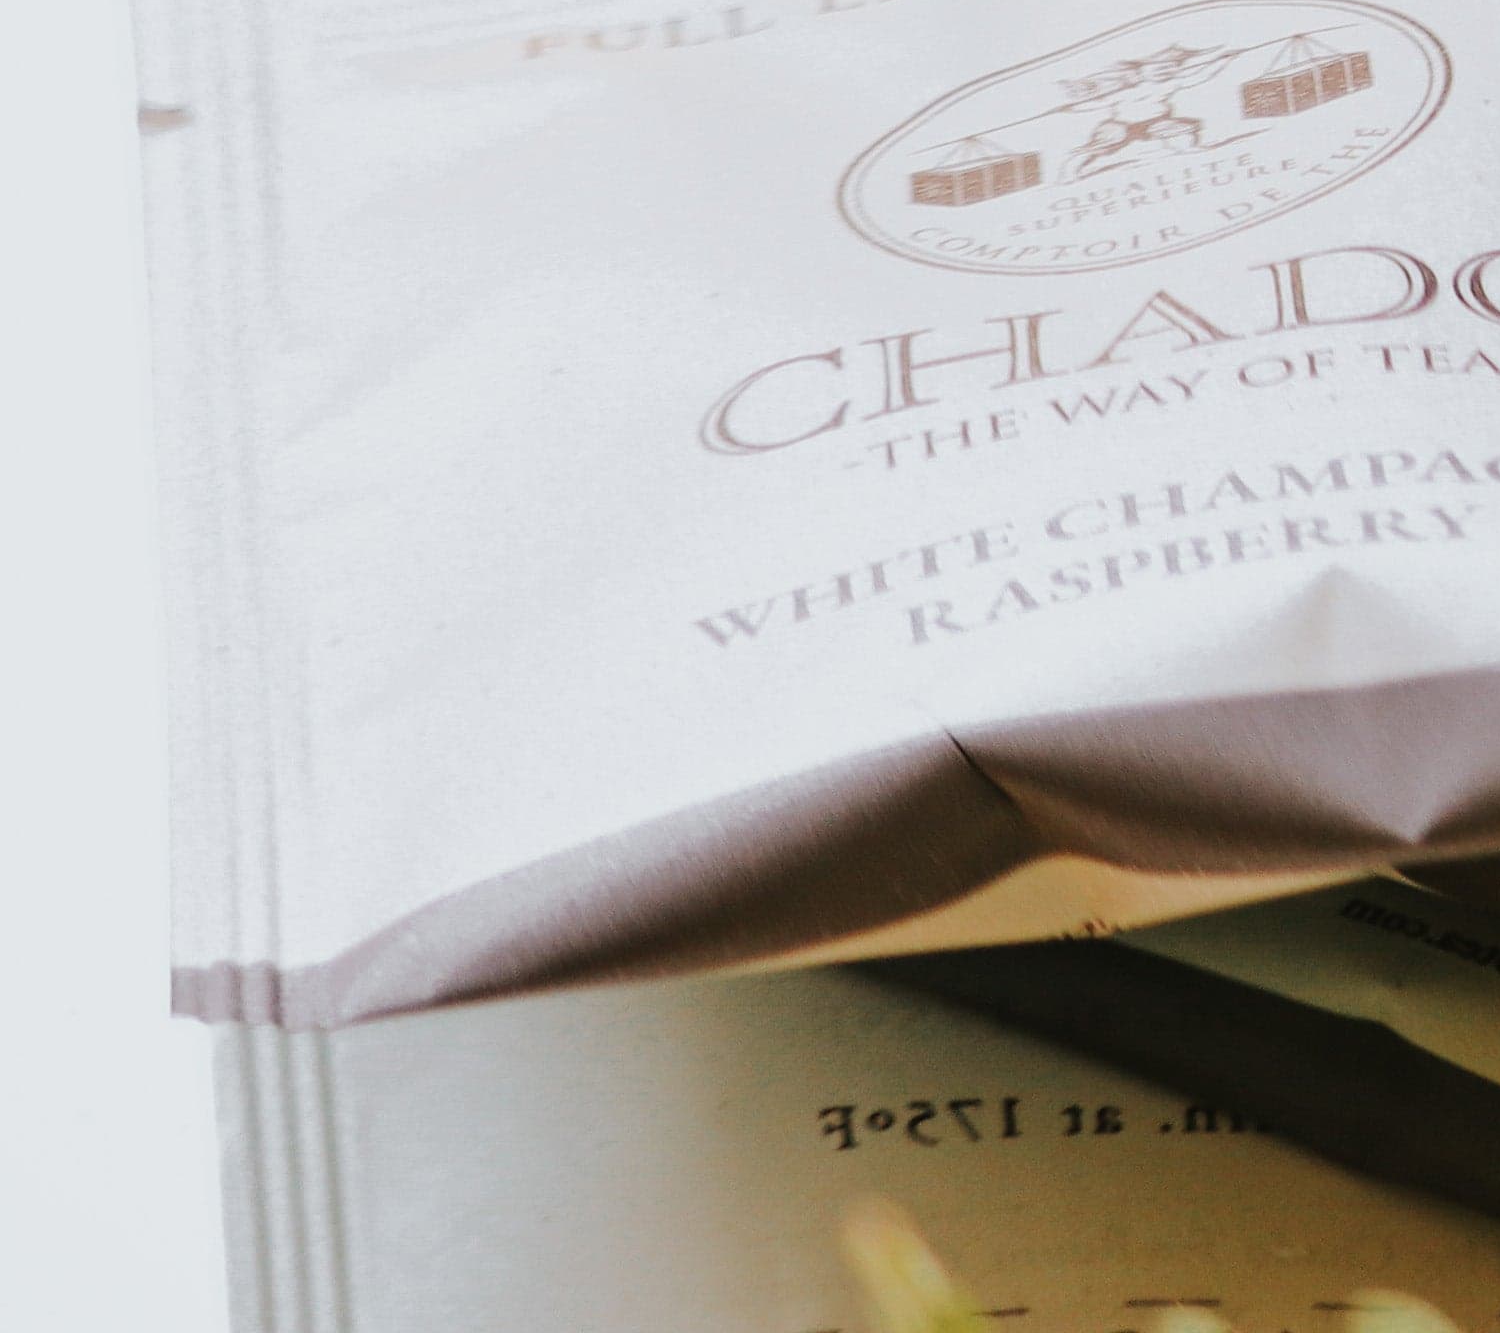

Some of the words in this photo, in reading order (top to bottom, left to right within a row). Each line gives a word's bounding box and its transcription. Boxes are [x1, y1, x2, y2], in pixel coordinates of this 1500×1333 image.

[517, 4, 775, 61] FULL
[909, 224, 1190, 262] COMPTOIR
[1217, 188, 1289, 221] DE
[1050, 369, 1206, 425] WAY
[1236, 347, 1336, 389] OF
[690, 520, 1020, 651] WHITE
[907, 503, 1488, 646] RASPBERRY
